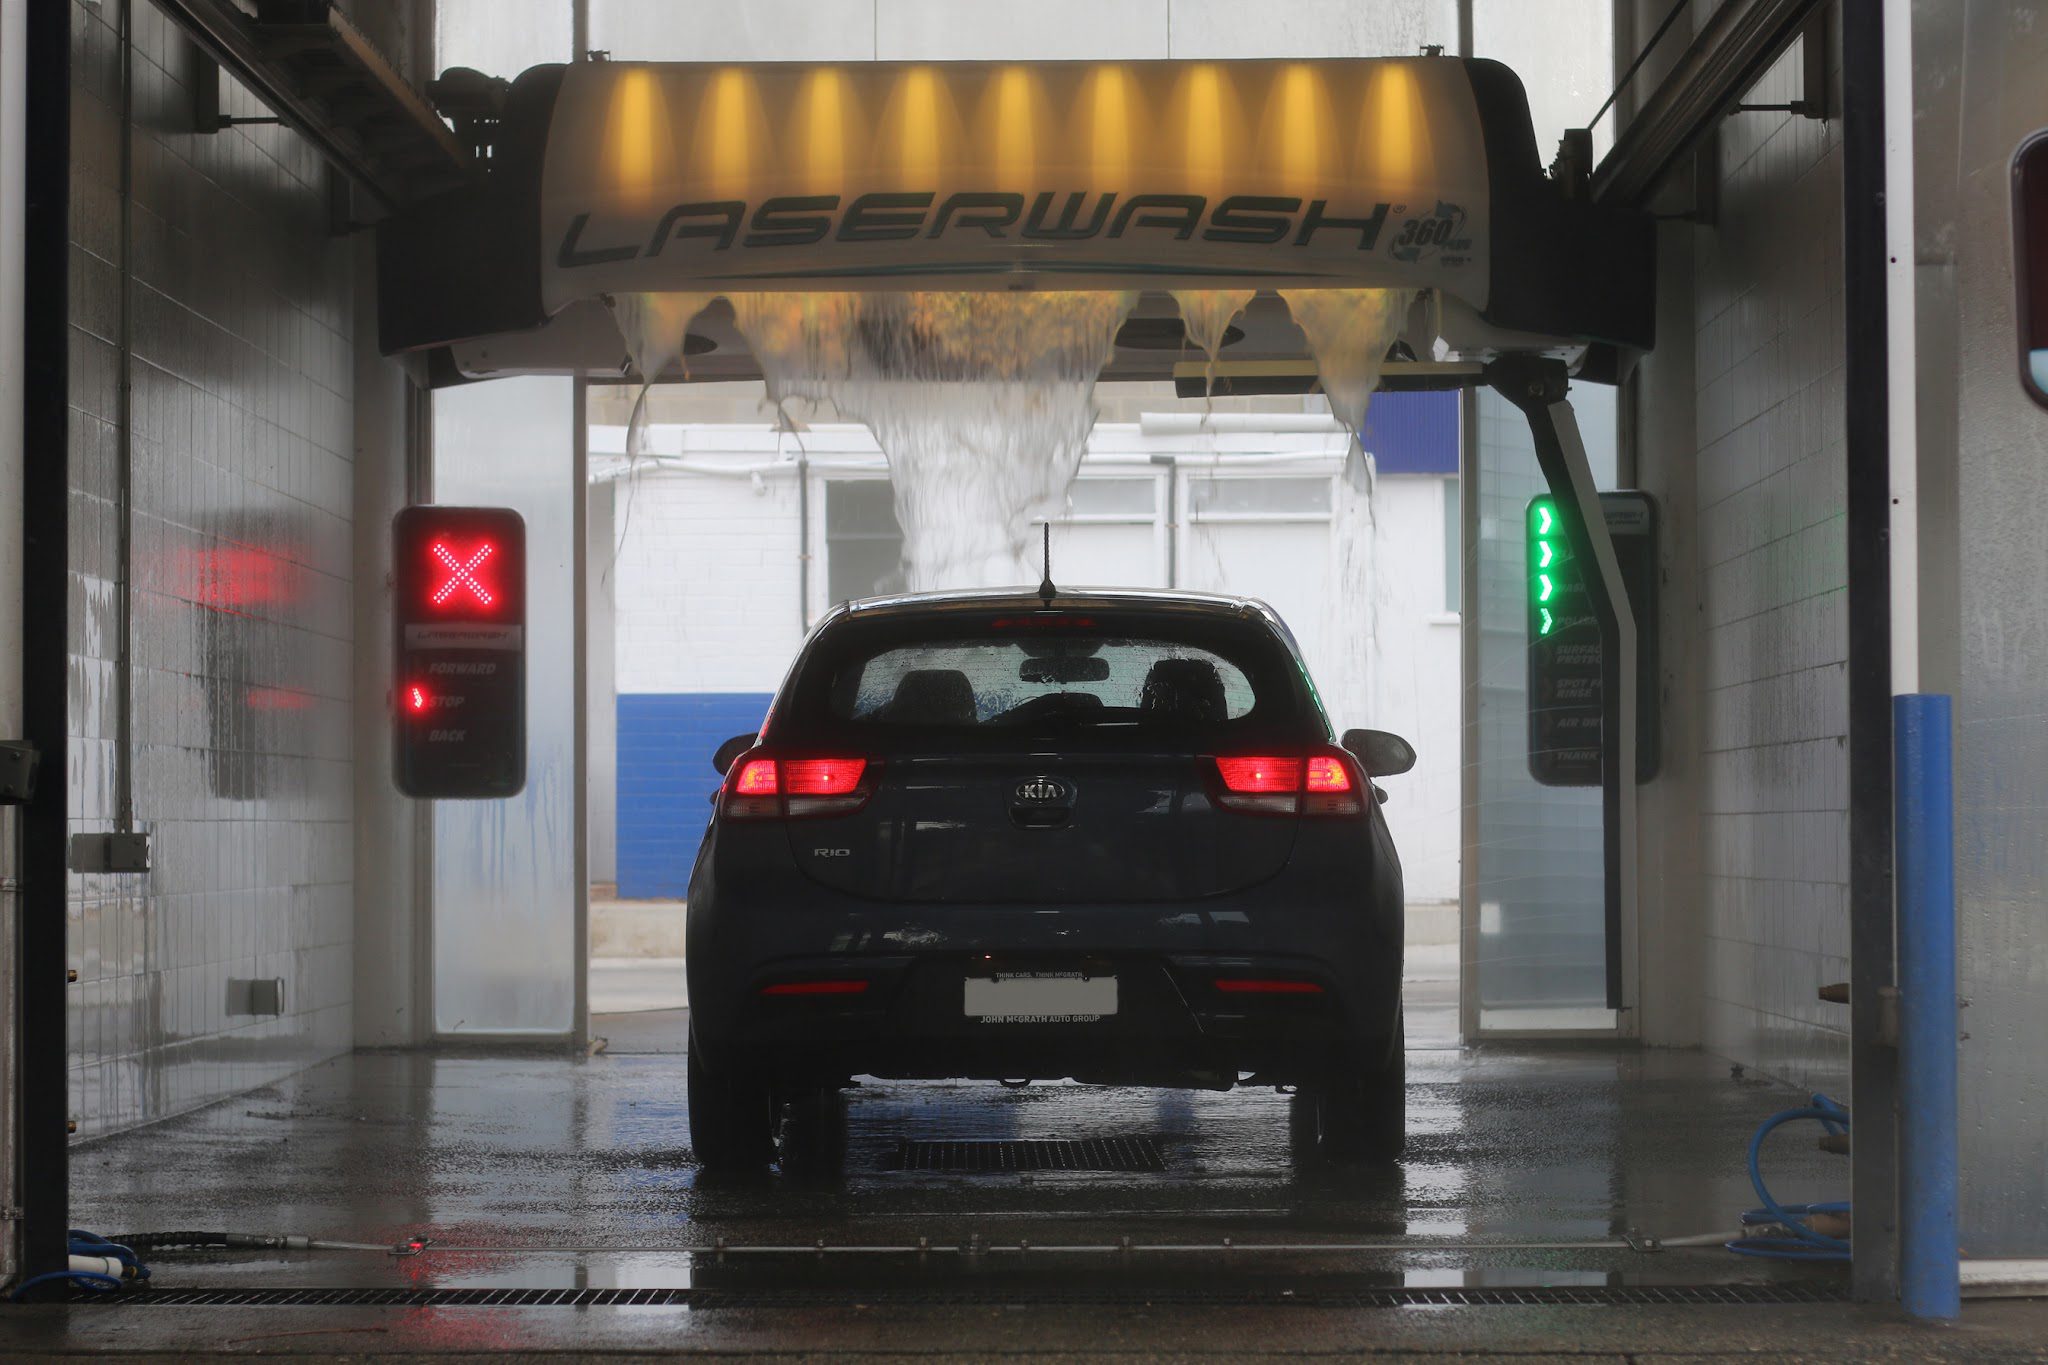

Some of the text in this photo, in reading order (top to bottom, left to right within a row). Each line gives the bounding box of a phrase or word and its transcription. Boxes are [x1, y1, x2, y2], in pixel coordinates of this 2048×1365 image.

[559, 191, 1391, 267] LASERWASH
[1398, 218, 1453, 247] 360
[1556, 645, 1602, 654] SURFAC
[1556, 655, 1602, 664] PROTEC
[429, 663, 497, 675] FORWARD
[1556, 679, 1586, 688] SPOT
[1556, 688, 1592, 698] RINSE
[429, 696, 465, 708] STOP
[1556, 718, 1579, 728] AIR
[429, 730, 466, 741] BACK
[1557, 751, 1598, 761] THANK
[1024, 784, 1057, 798] KIA
[814, 848, 850, 857] RIO
[980, 1015, 1003, 1024] JOHN
[1049, 1015, 1070, 1023] AUTO
[1072, 1014, 1100, 1023] GROUP
